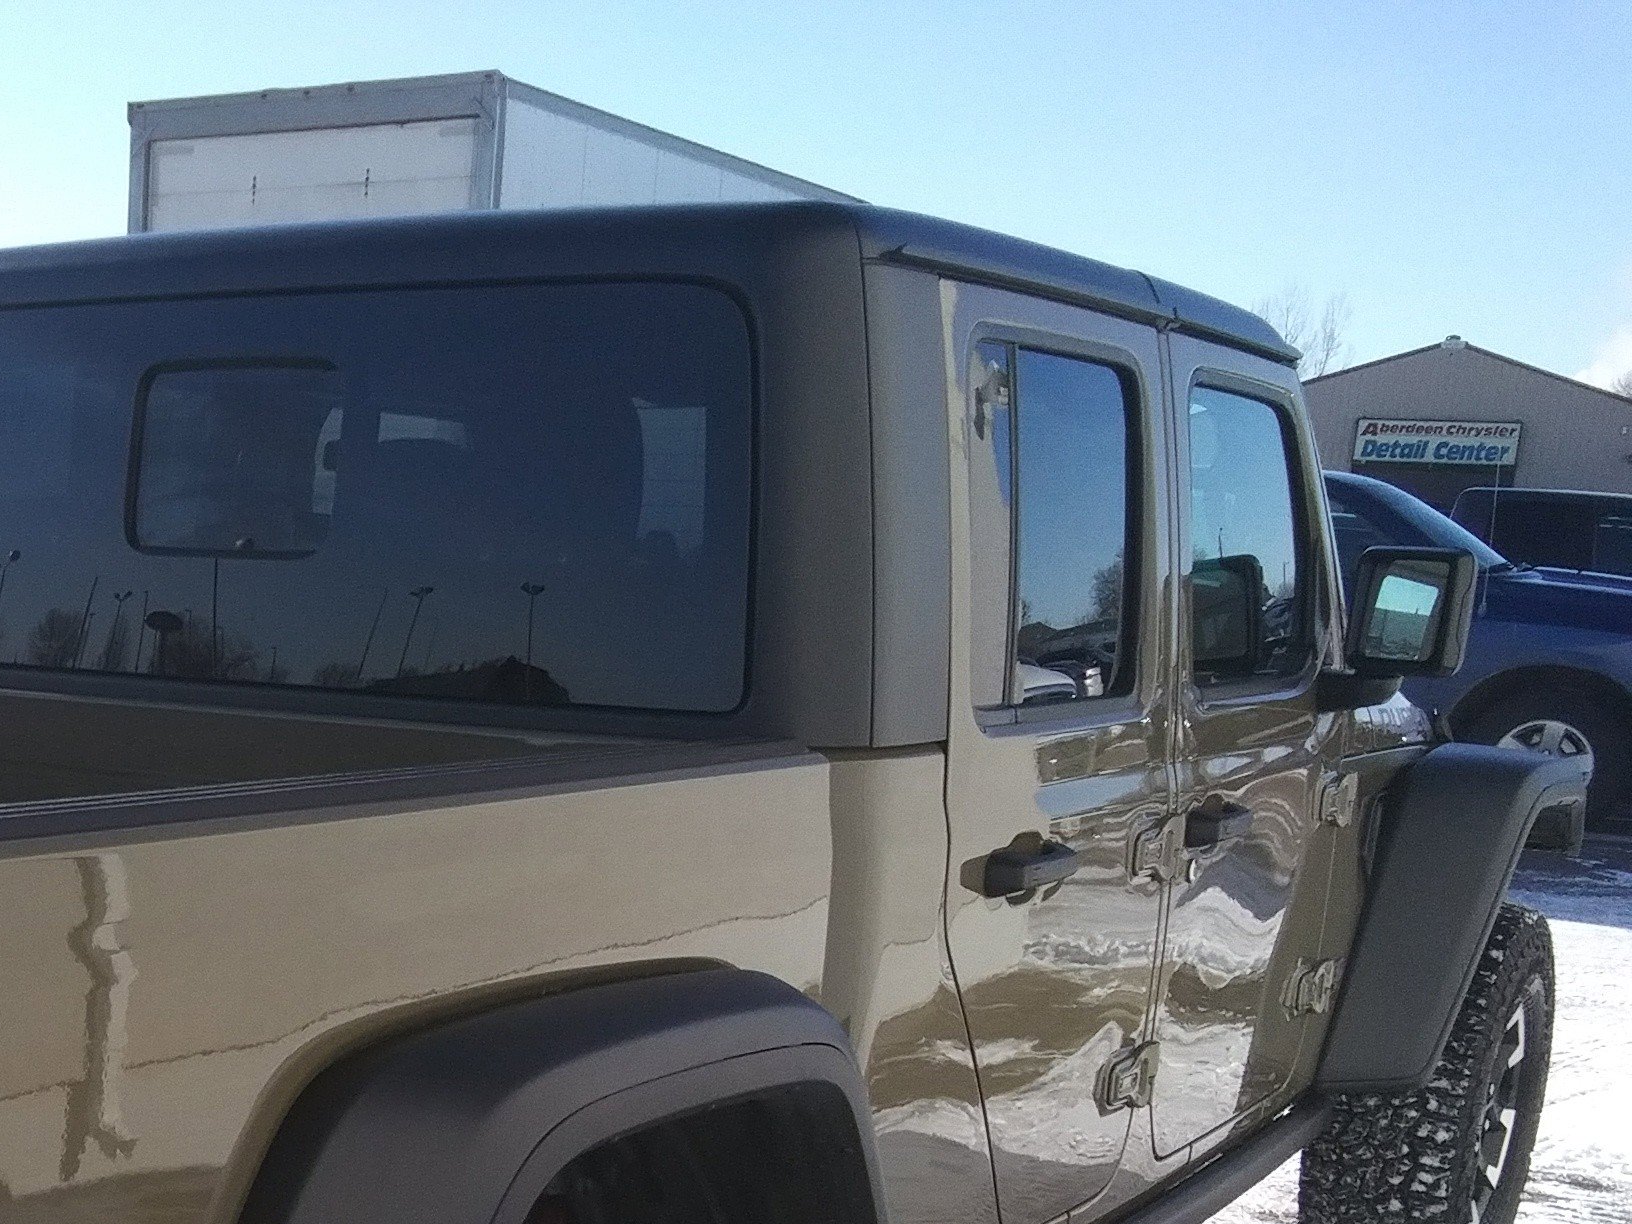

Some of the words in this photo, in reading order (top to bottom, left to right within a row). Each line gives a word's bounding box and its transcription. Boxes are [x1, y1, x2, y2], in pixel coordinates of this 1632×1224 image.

[1360, 422, 1443, 437] Aberdeen
[1446, 424, 1518, 438] Chrysler
[1360, 439, 1430, 460] Detail
[1432, 440, 1511, 462] Center
